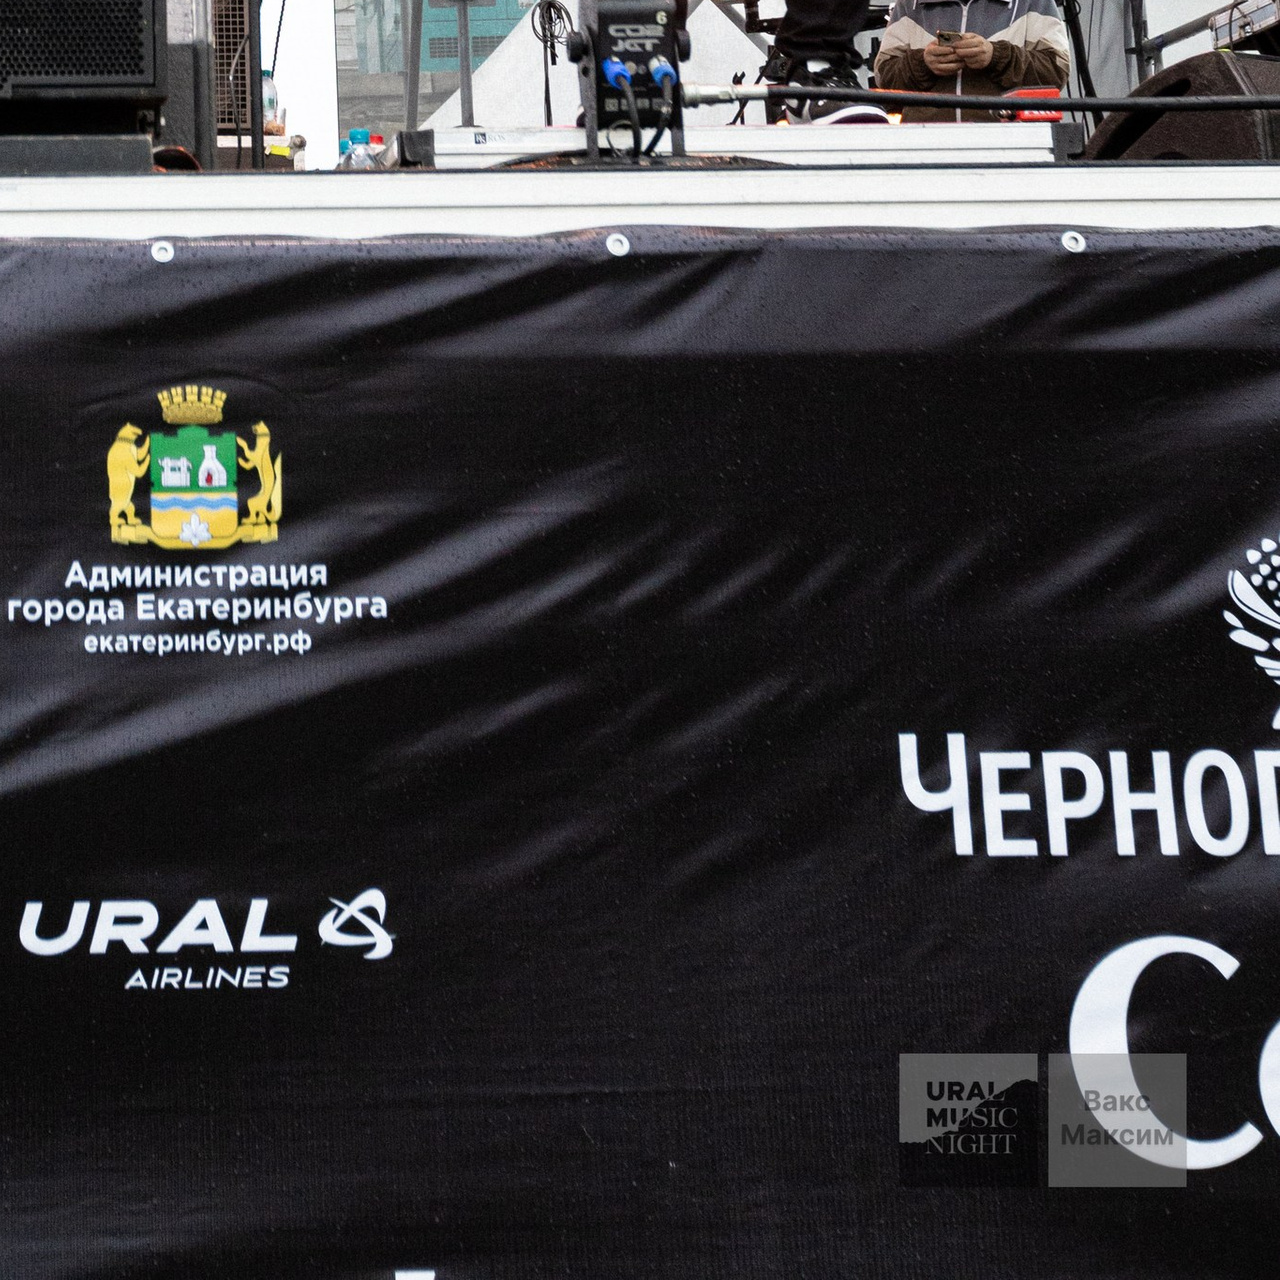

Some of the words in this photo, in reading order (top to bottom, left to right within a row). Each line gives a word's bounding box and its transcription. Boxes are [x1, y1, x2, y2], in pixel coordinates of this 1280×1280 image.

[655, 10, 668, 25] 6
[65, 561, 327, 592] Администрация
[8, 598, 124, 626] города
[137, 592, 387, 624] Екатеринбурга
[84, 630, 312, 656] екатеринбург.рф
[19, 898, 298, 956] URAL
[125, 966, 290, 990] AIRLINES
